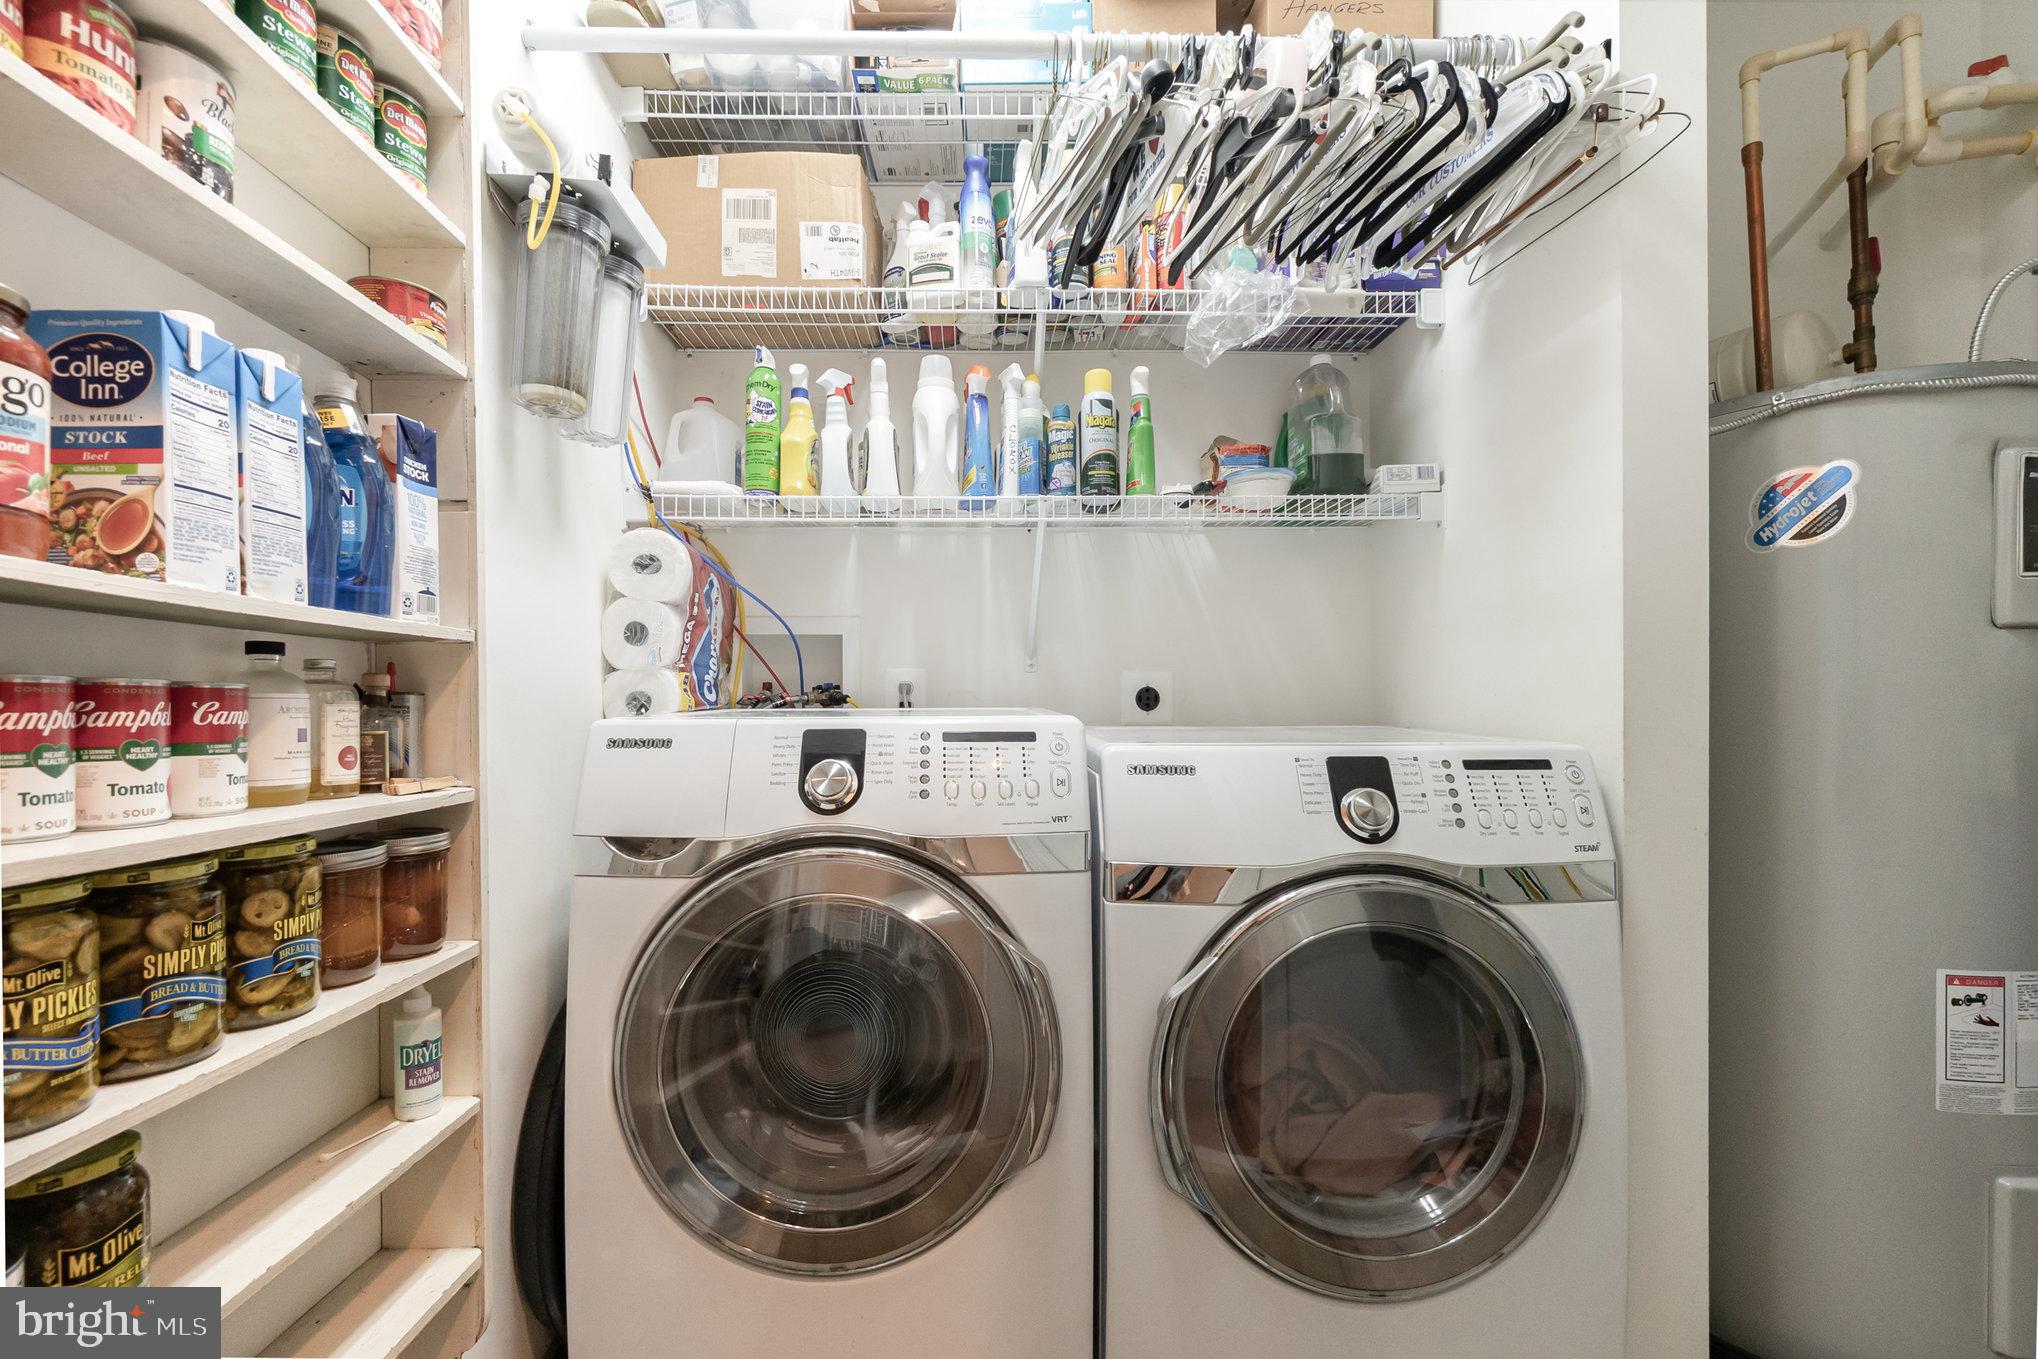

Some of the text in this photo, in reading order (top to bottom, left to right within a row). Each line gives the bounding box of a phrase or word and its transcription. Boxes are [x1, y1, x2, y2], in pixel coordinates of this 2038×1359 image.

[1282, 0, 1385, 19] HANGERS
[51, 49, 124, 95] Tomato
[340, 56, 359, 77] Del
[883, 79, 915, 90] VALUE
[386, 106, 404, 125] Del
[384, 131, 428, 169] Stewed
[51, 355, 145, 383] College
[169, 369, 228, 399] Nutrition Facts
[89, 413, 134, 422] NATURAL
[247, 402, 297, 427] Nutrition Facts
[218, 419, 230, 429] 20
[64, 431, 128, 444] STOCK
[1048, 430, 1075, 444] Magic
[82, 452, 111, 461] Beef
[288, 446, 299, 455] 20
[403, 463, 430, 482] STOCK
[1759, 491, 1818, 543] Hydrojet
[606, 737, 673, 749] SAMSUNG
[125, 752, 159, 760] HEALTHY
[1126, 764, 1197, 776] SAMSUNG
[106, 781, 165, 797] Tomato
[122, 807, 157, 819] SOUP
[1051, 815, 1068, 823] VRT
[35, 818, 68, 831] SOUP
[1574, 844, 1600, 853] STEAM
[194, 924, 207, 938] Mt.
[273, 913, 316, 941] SIMPLY
[143, 945, 207, 980] SIMPLY
[25, 967, 62, 990] Olive
[150, 982, 188, 1002] BREAD
[32, 978, 98, 1026] PICKLES
[11, 1046, 68, 1061] BUTTER
[408, 1070, 441, 1087] REMOVER
[414, 1065, 435, 1078] STAIN
[68, 1223, 142, 1279] Mt. Olive
